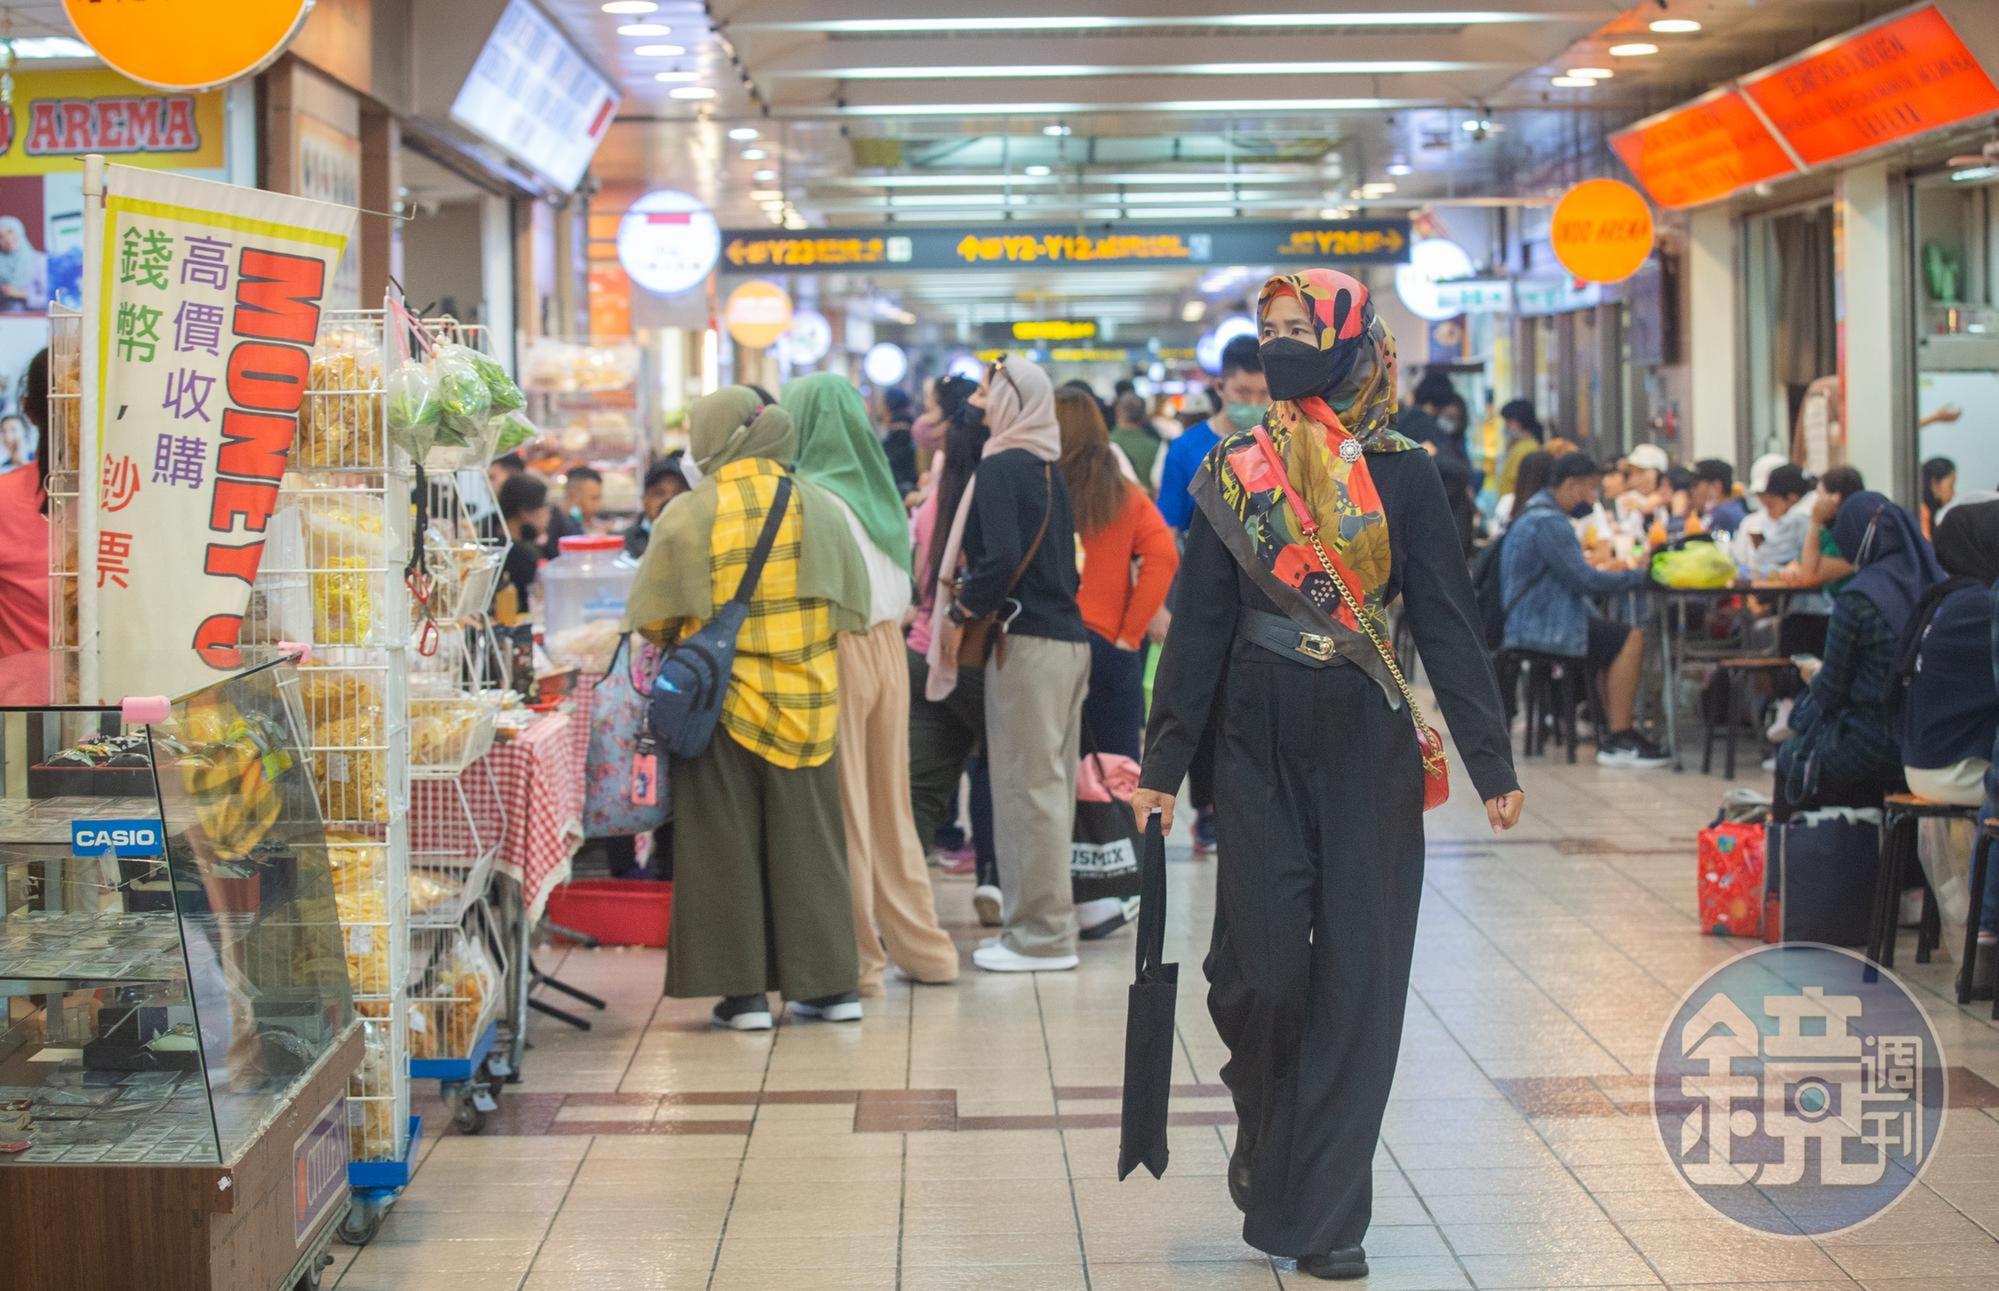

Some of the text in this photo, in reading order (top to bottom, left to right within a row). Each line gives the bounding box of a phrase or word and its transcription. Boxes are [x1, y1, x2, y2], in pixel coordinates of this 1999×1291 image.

[28, 97, 198, 153] AREMA
[152, 234, 233, 490] 高價收購
[204, 246, 326, 588] MONEY
[76, 829, 155, 847] CASIO
